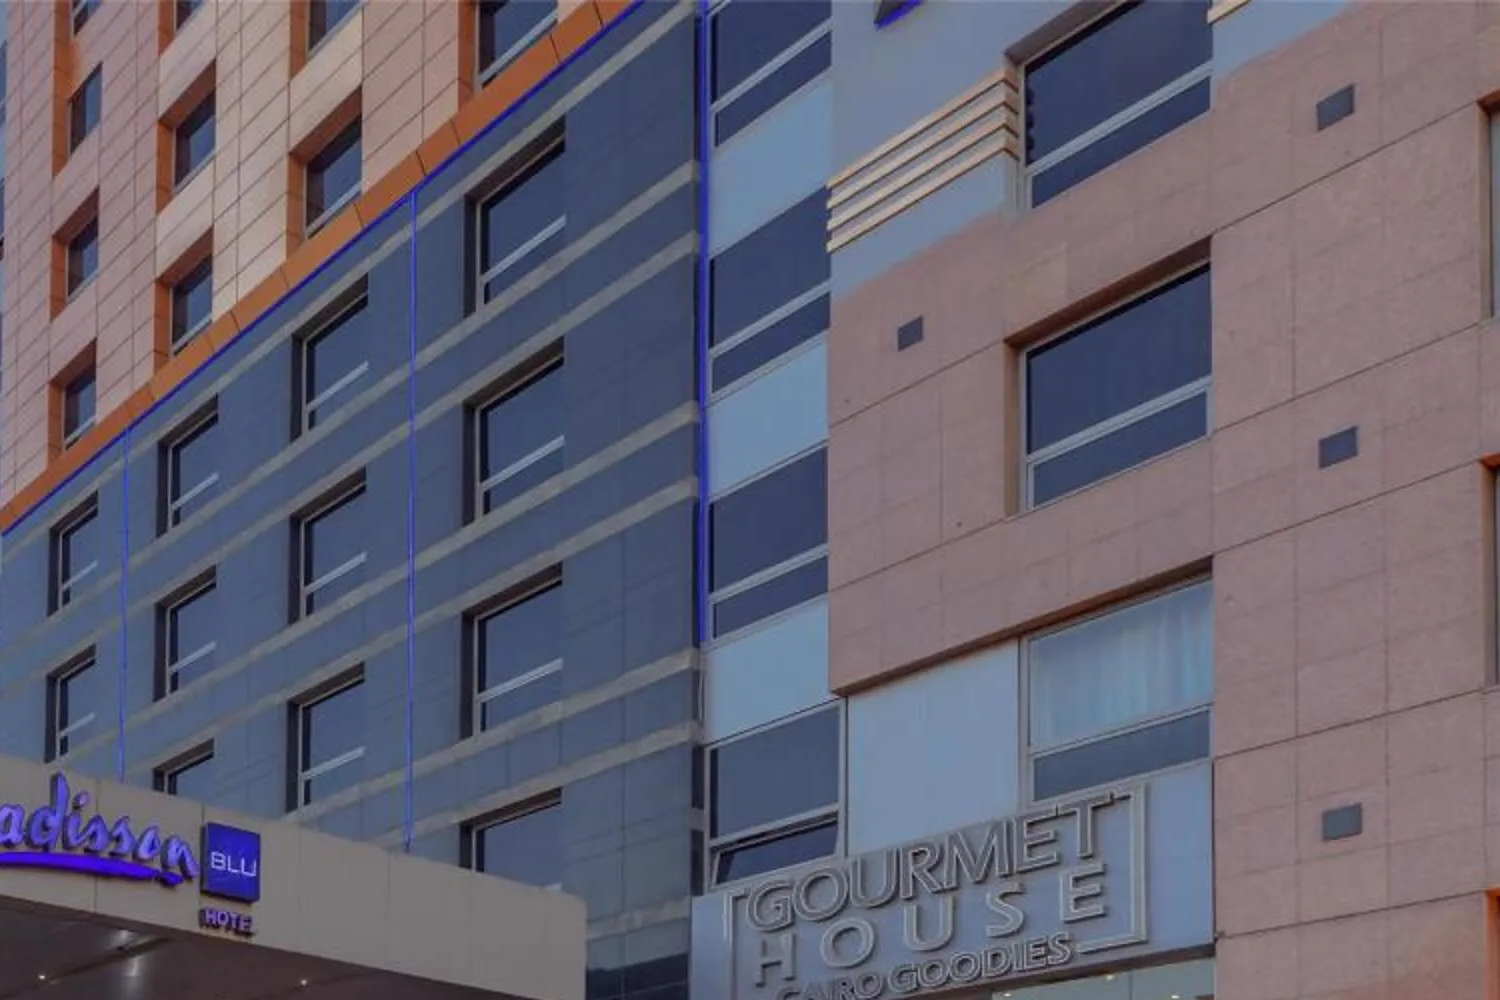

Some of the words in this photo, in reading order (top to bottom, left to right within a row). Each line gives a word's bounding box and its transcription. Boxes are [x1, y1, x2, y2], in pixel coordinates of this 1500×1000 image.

[211, 851, 257, 877] BLU
[747, 798, 1112, 931] GOURMET
[204, 908, 259, 934] HOTE
[754, 862, 1108, 988] HOUSE
[888, 932, 1074, 991] GOODIES
